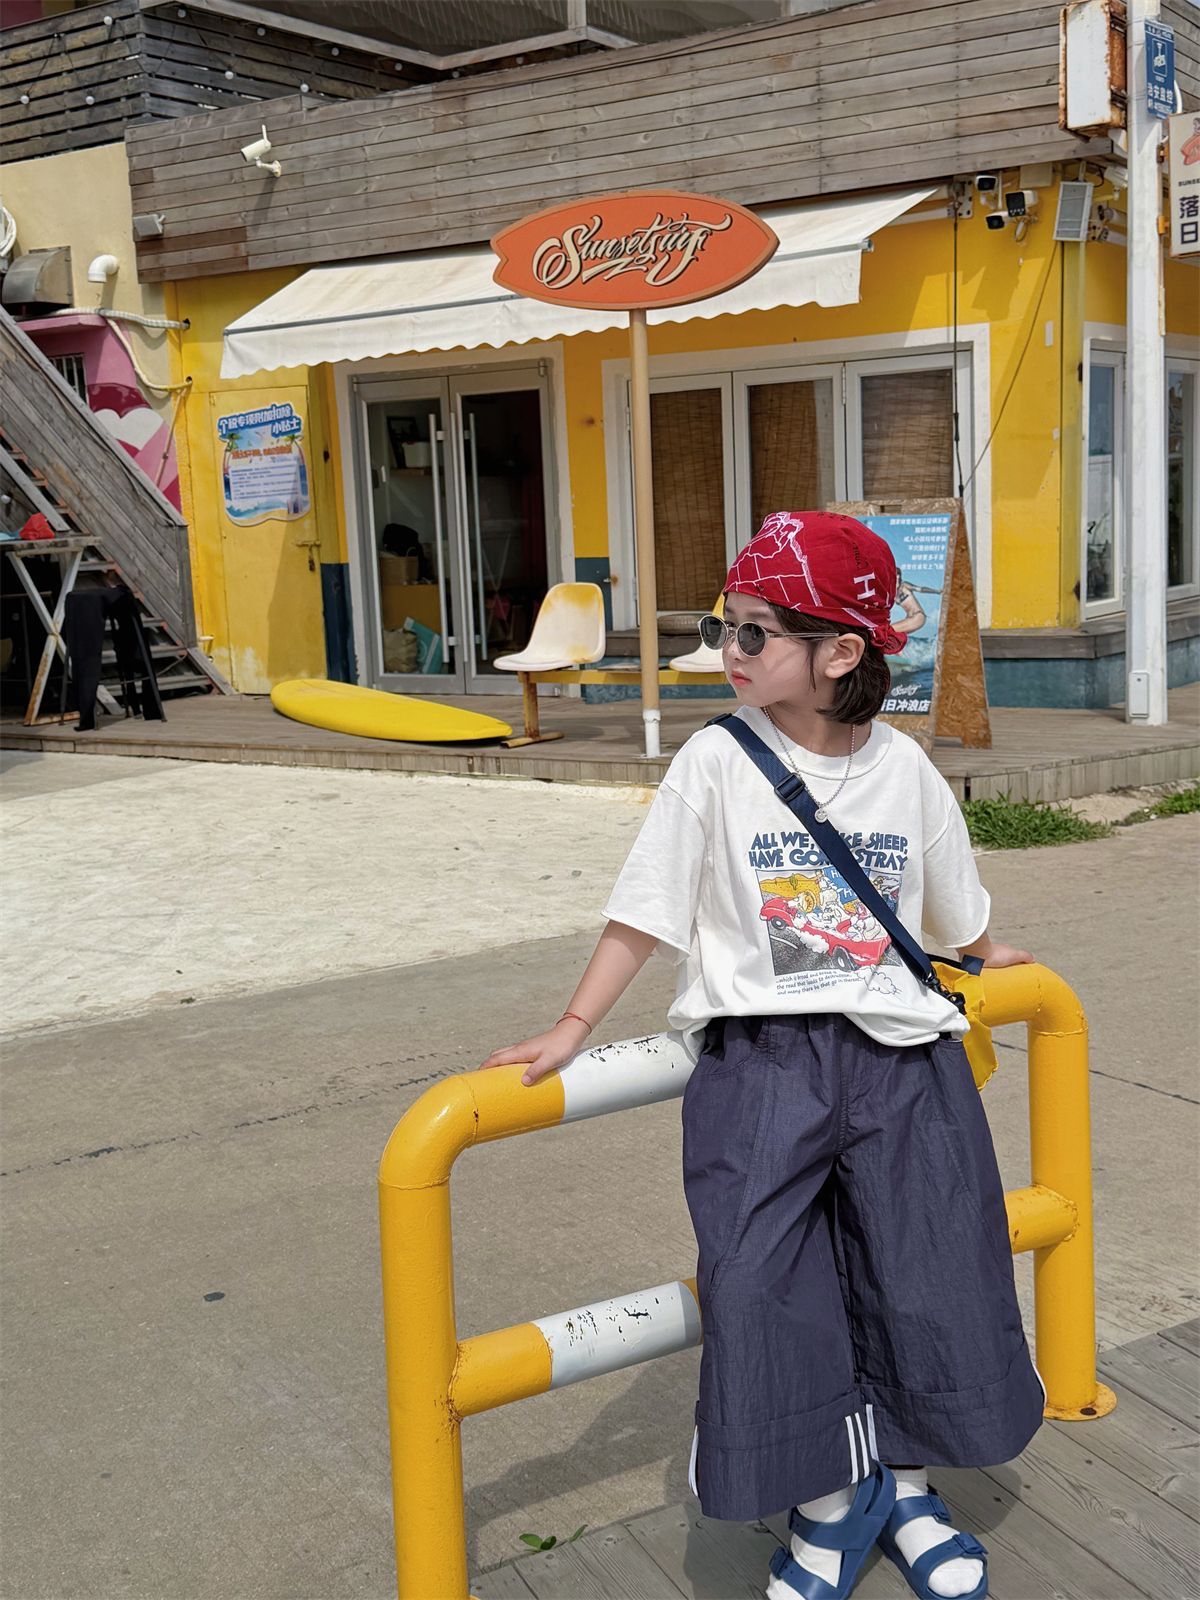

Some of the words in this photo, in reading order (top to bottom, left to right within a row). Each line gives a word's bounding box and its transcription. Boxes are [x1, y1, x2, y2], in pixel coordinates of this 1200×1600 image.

[1179, 195, 1199, 244] 落日
[272, 419, 300, 434] 小贴士
[751, 832, 778, 851] ALL
[781, 832, 814, 851] WE,
[866, 832, 908, 855] SHEEP,
[749, 849, 783, 869] HAVE
[854, 849, 908, 872] STRAY.
